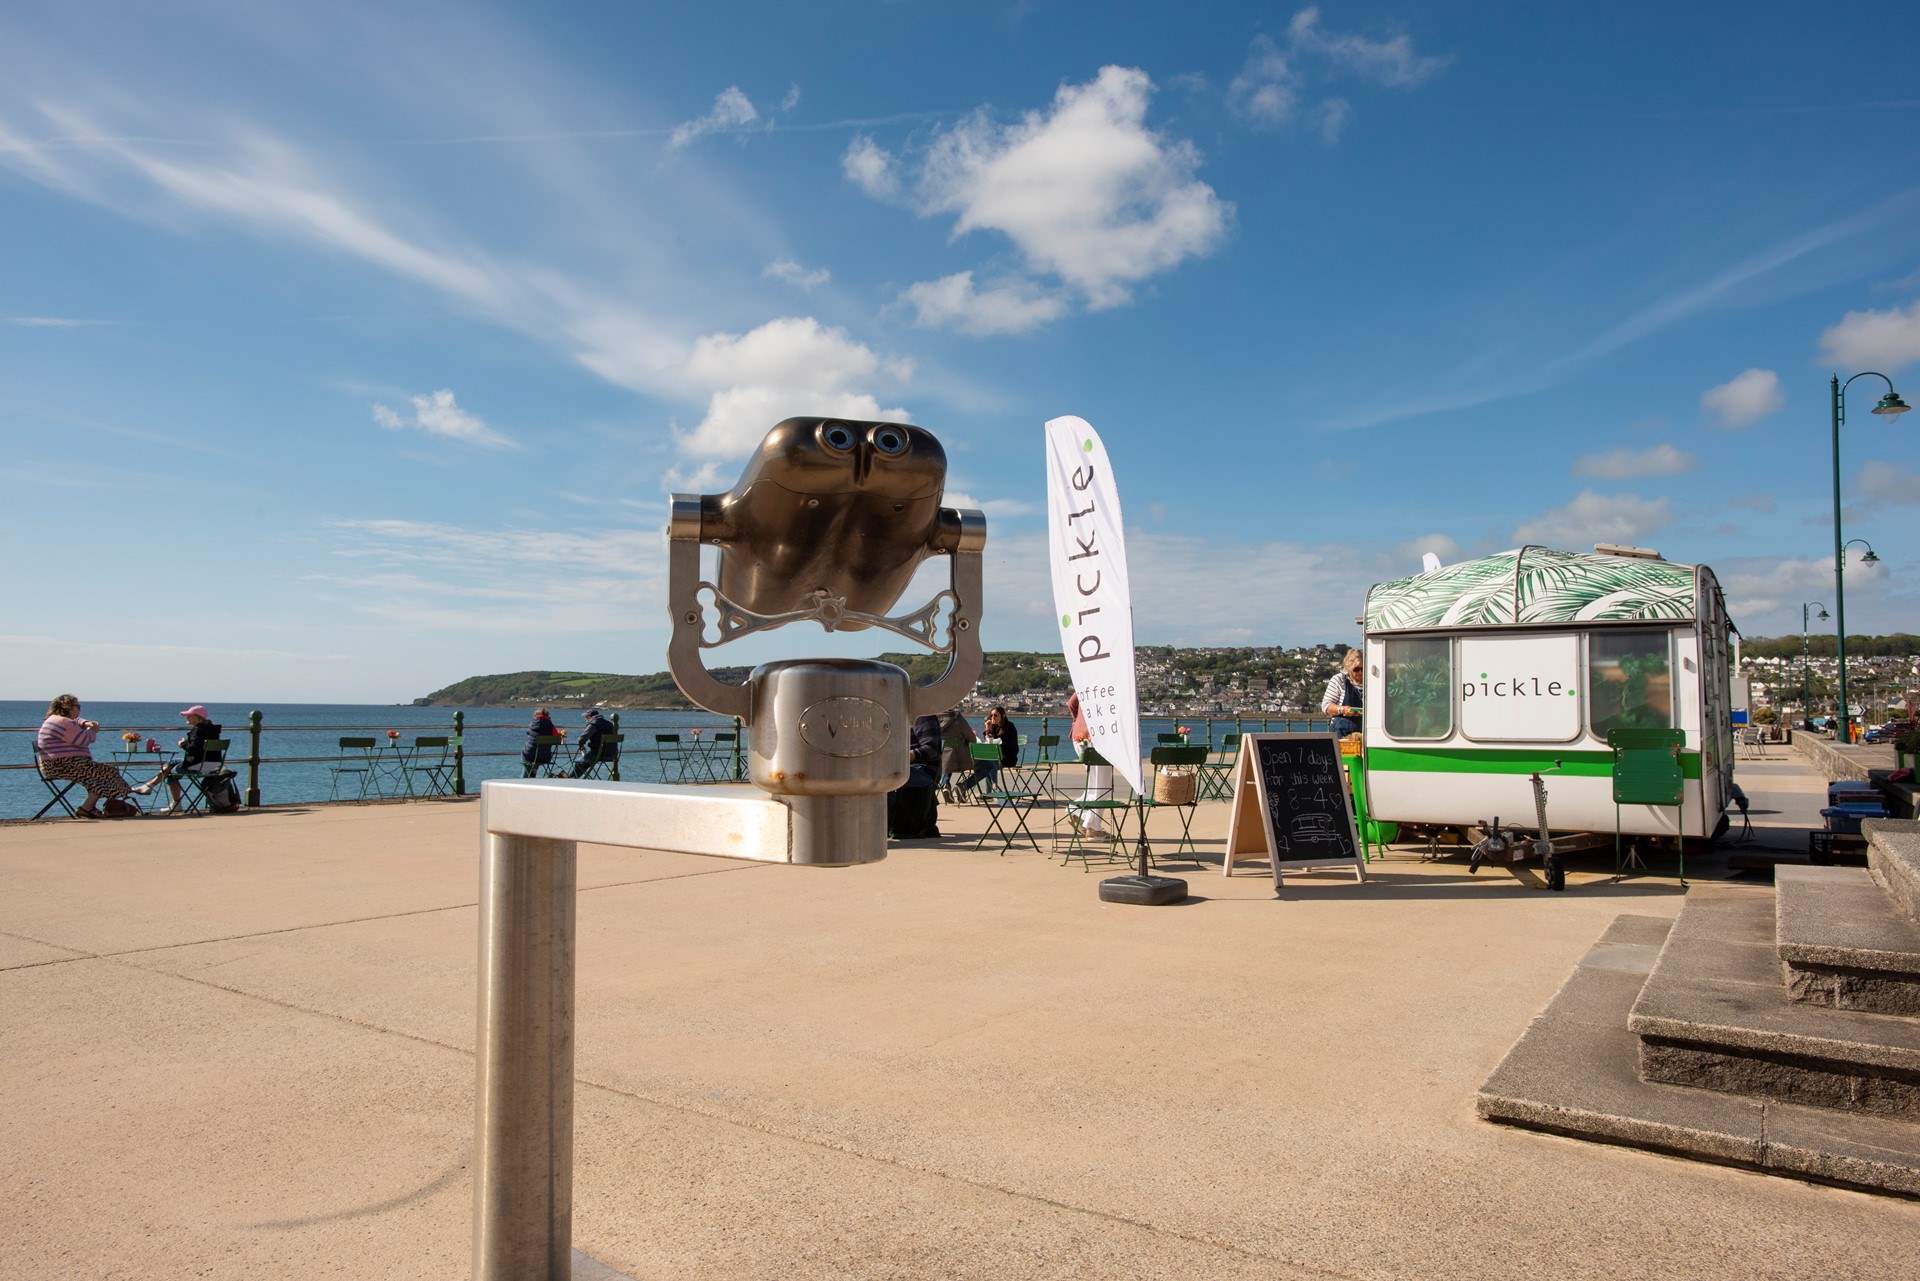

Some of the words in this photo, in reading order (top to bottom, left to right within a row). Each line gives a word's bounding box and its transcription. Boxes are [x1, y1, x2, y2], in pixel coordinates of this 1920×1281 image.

[1077, 685, 1115, 702] offee
[1086, 704, 1116, 719] ake
[1090, 720, 1118, 737] ood
[1263, 746, 1292, 774] Open
[1308, 750, 1332, 773] days
[1290, 770, 1309, 786] this
[1311, 773, 1335, 785] week
